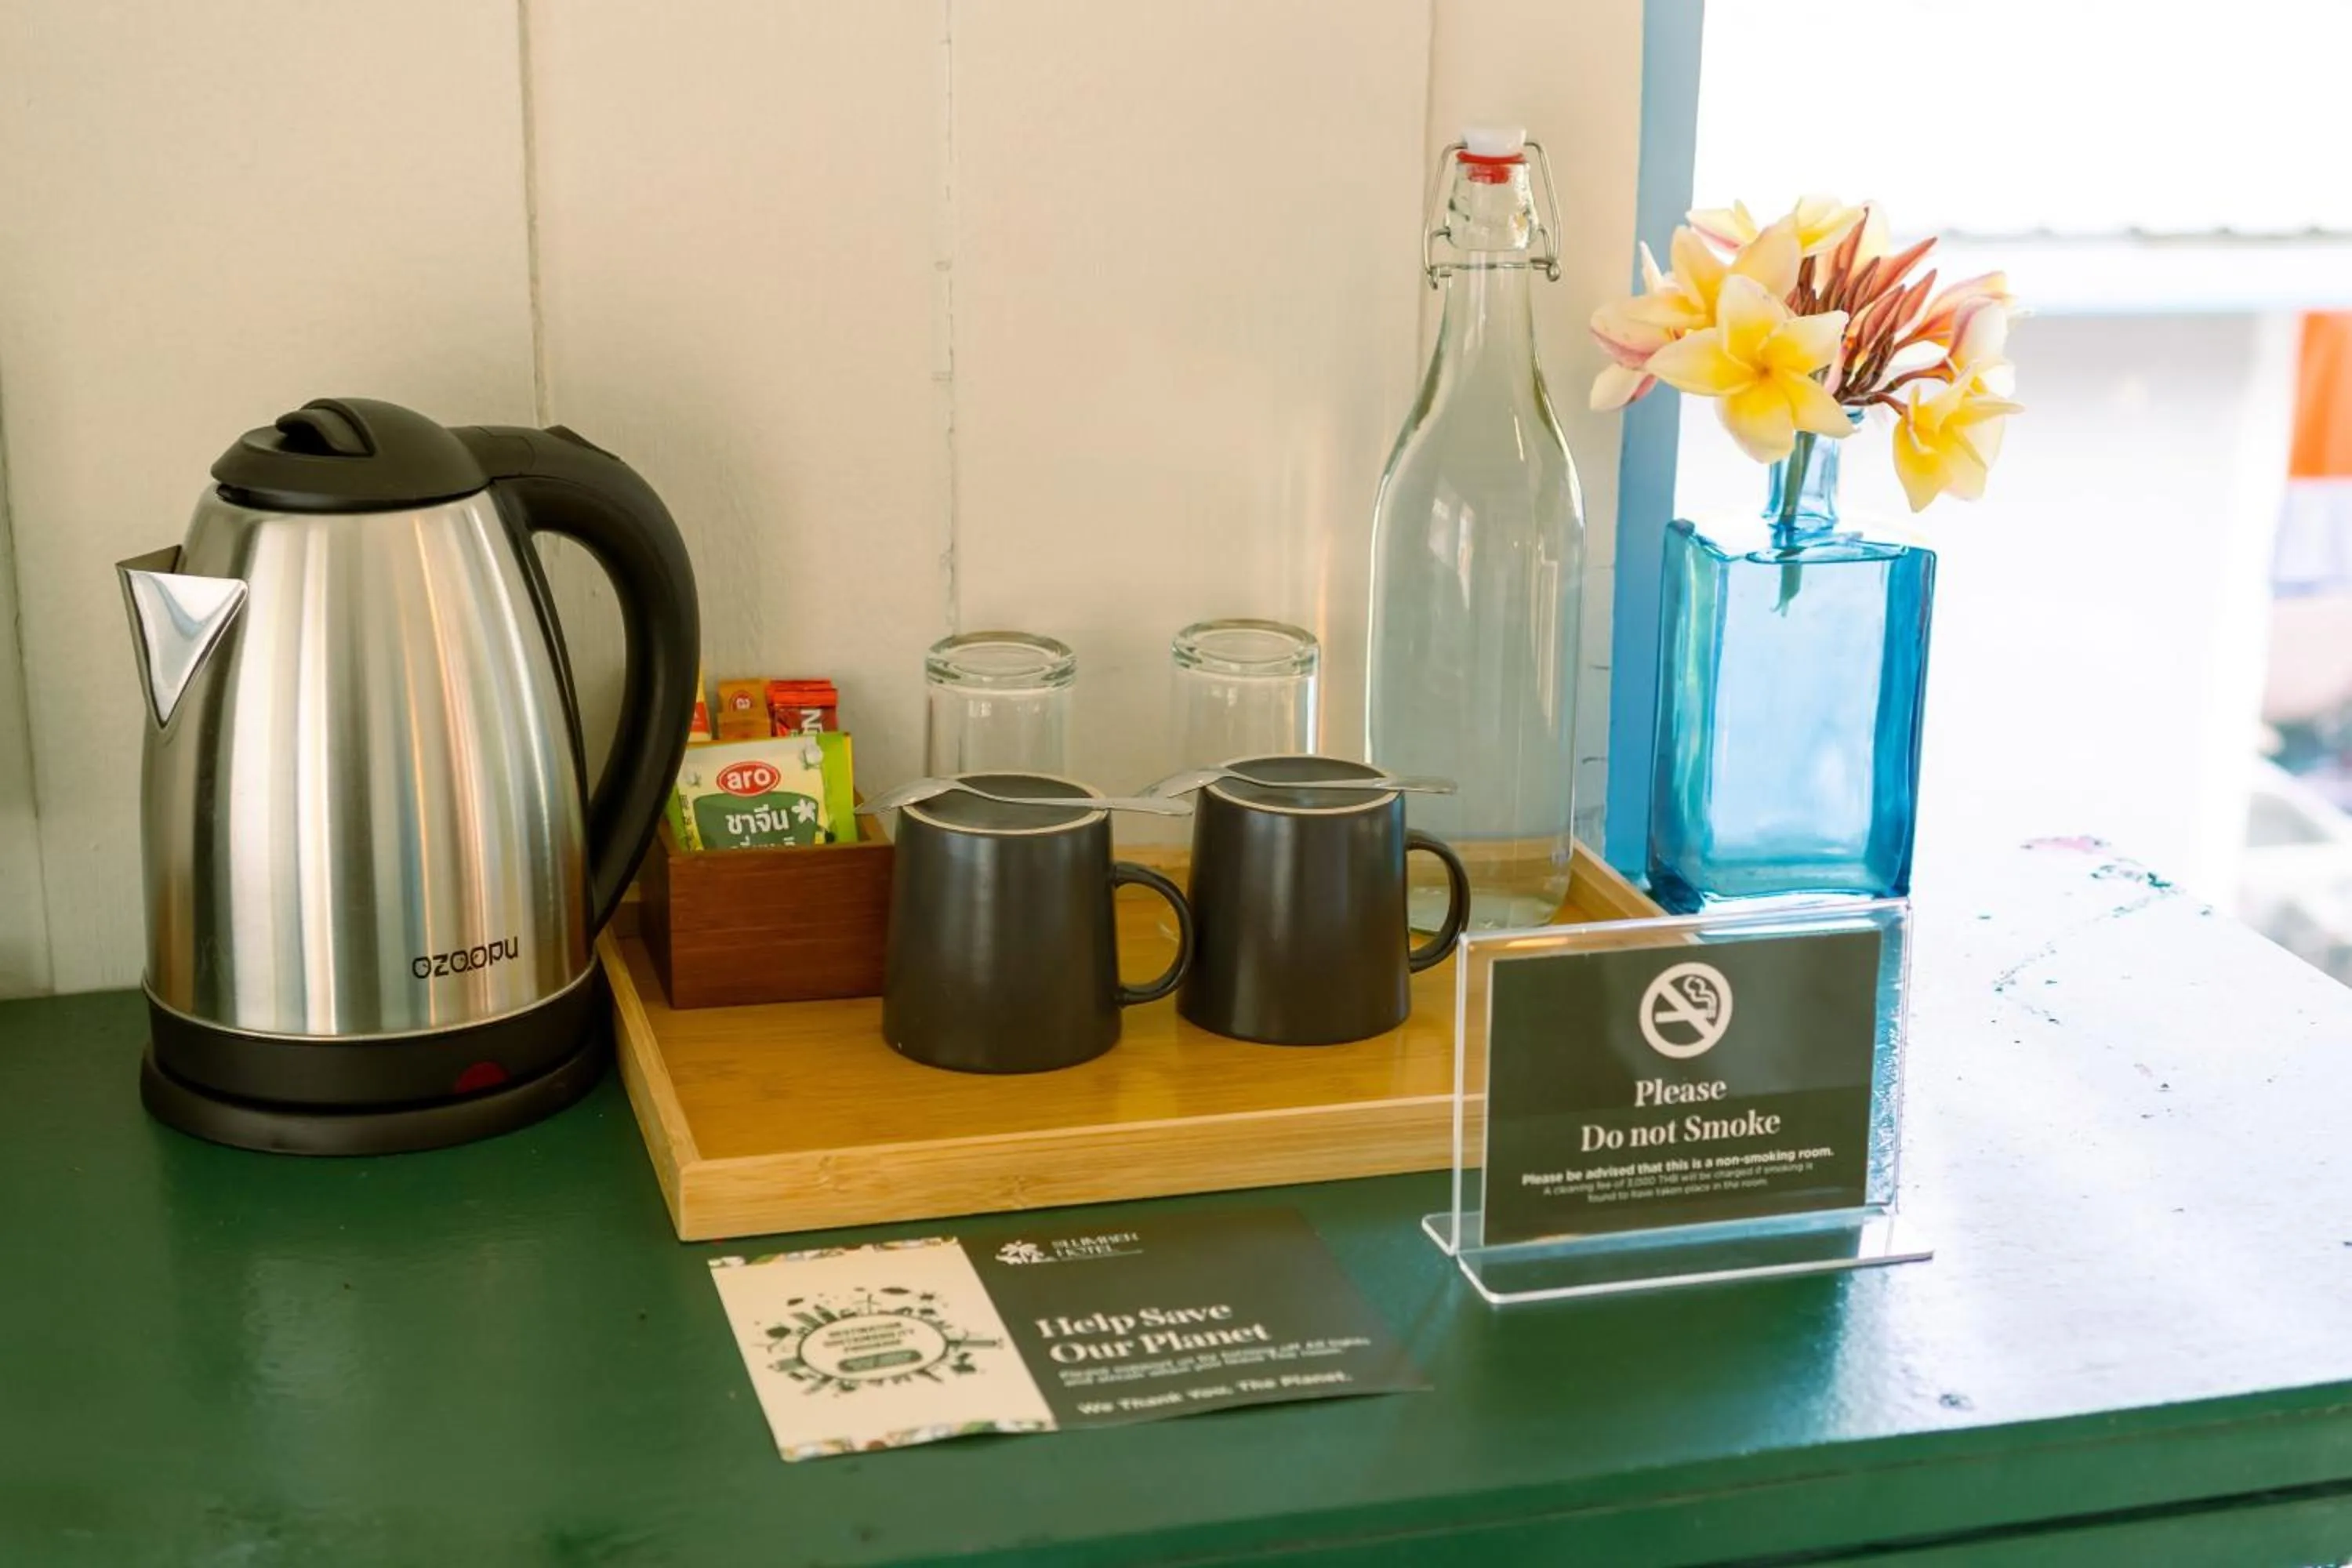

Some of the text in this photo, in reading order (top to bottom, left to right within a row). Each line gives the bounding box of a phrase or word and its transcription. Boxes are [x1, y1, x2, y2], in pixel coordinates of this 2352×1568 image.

[727, 768, 771, 790] aro
[725, 803, 789, 835] ชาจีน
[1634, 1078, 1727, 1108] Please
[1581, 1109, 1781, 1152] Do not Smoke
[1522, 1146, 1835, 1186] Please be advised that this is a non-smoking room.
[1035, 1303, 1233, 1338] Help Save
[1049, 1323, 1272, 1364] Our Planet
